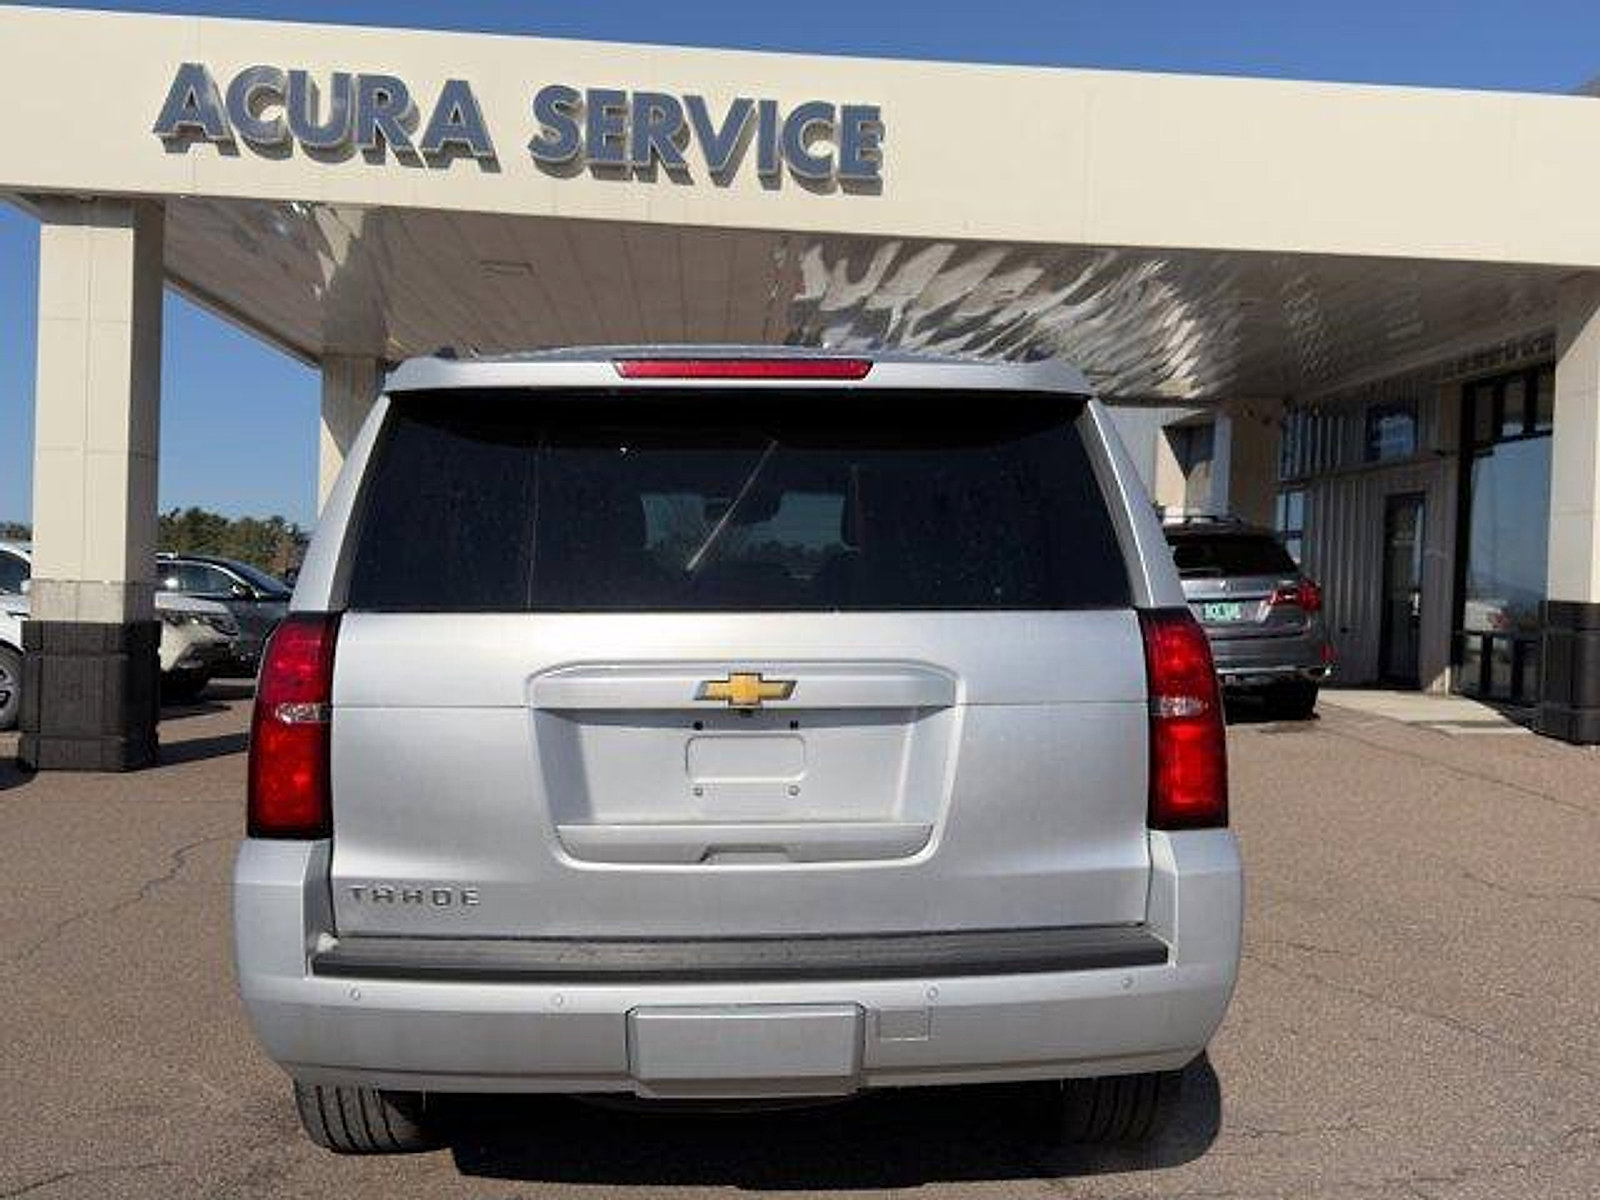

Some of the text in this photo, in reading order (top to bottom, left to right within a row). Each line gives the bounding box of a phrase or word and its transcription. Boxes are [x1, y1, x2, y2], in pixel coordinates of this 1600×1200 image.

[153, 62, 886, 194] ACURA SERVICE
[347, 884, 481, 907] TAHOE
